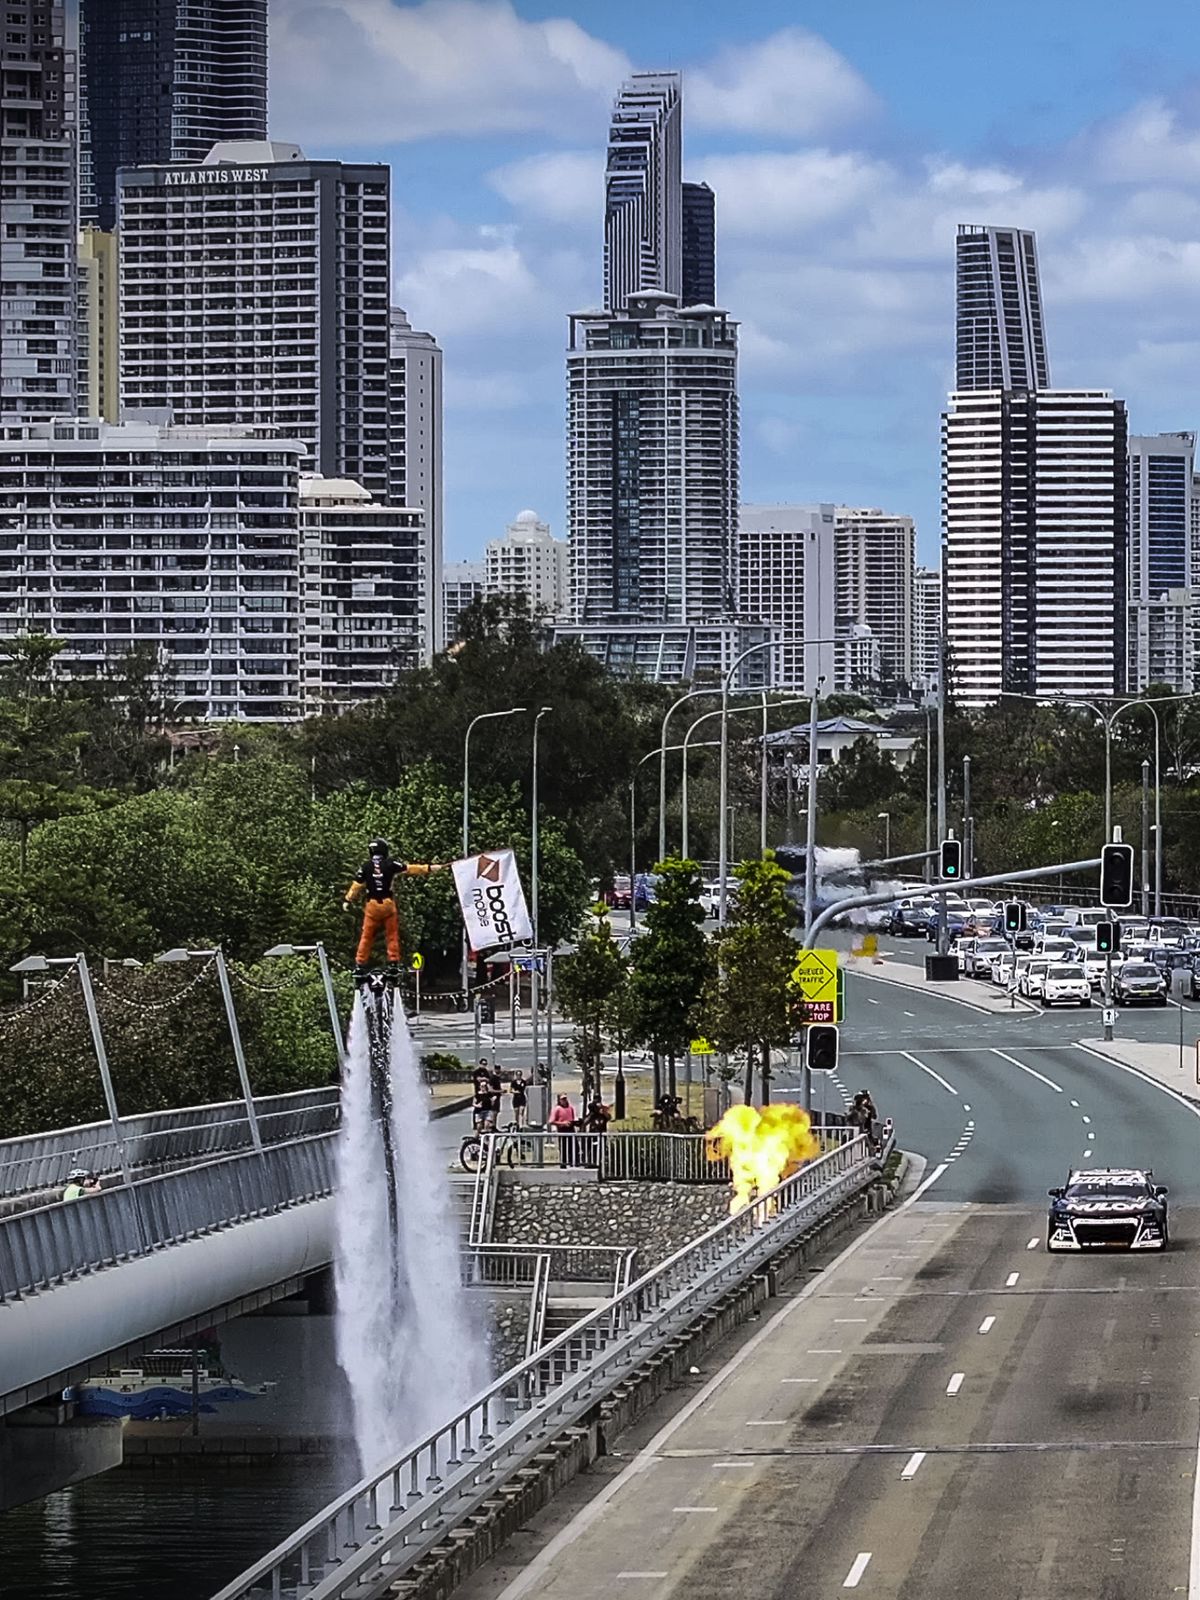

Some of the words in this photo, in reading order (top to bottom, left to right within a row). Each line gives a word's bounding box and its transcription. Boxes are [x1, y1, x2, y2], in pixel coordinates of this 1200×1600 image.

[164, 170, 229, 185] ATLANTIS
[231, 168, 269, 182] WEST
[486, 884, 517, 943] boost
[1066, 1201, 1148, 1212] NULON
